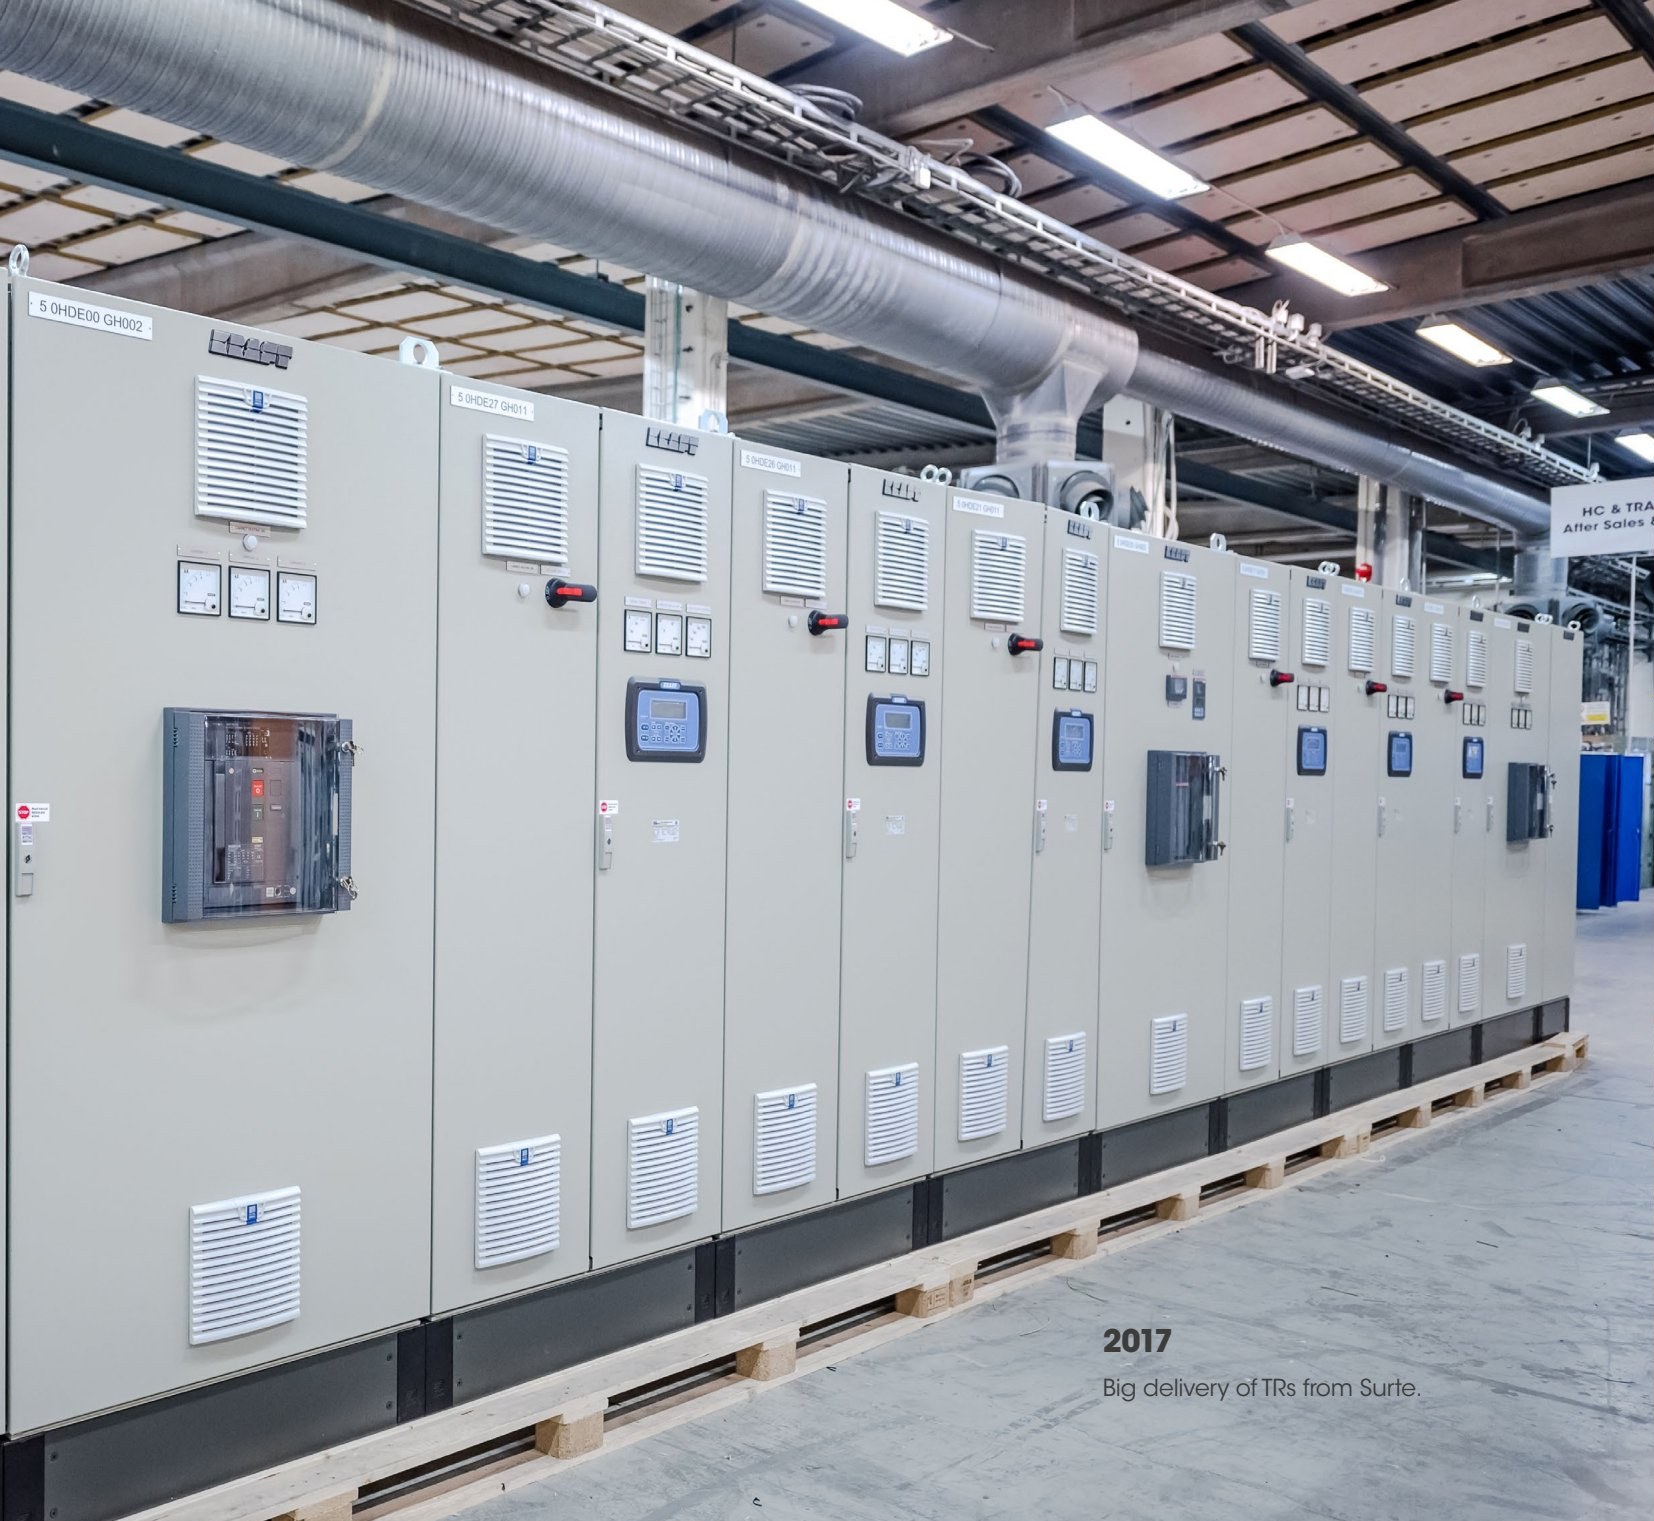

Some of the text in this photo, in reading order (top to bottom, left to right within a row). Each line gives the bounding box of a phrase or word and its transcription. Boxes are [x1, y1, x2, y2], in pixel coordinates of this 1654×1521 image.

[39, 299, 144, 333] 5 0HDE00 GH002
[457, 391, 464, 402] 5
[500, 400, 528, 416] GH011
[1582, 505, 1606, 517] HC
[1610, 504, 1621, 515] &
[1563, 522, 1599, 534] After
[1603, 518, 1645, 530] Sales
